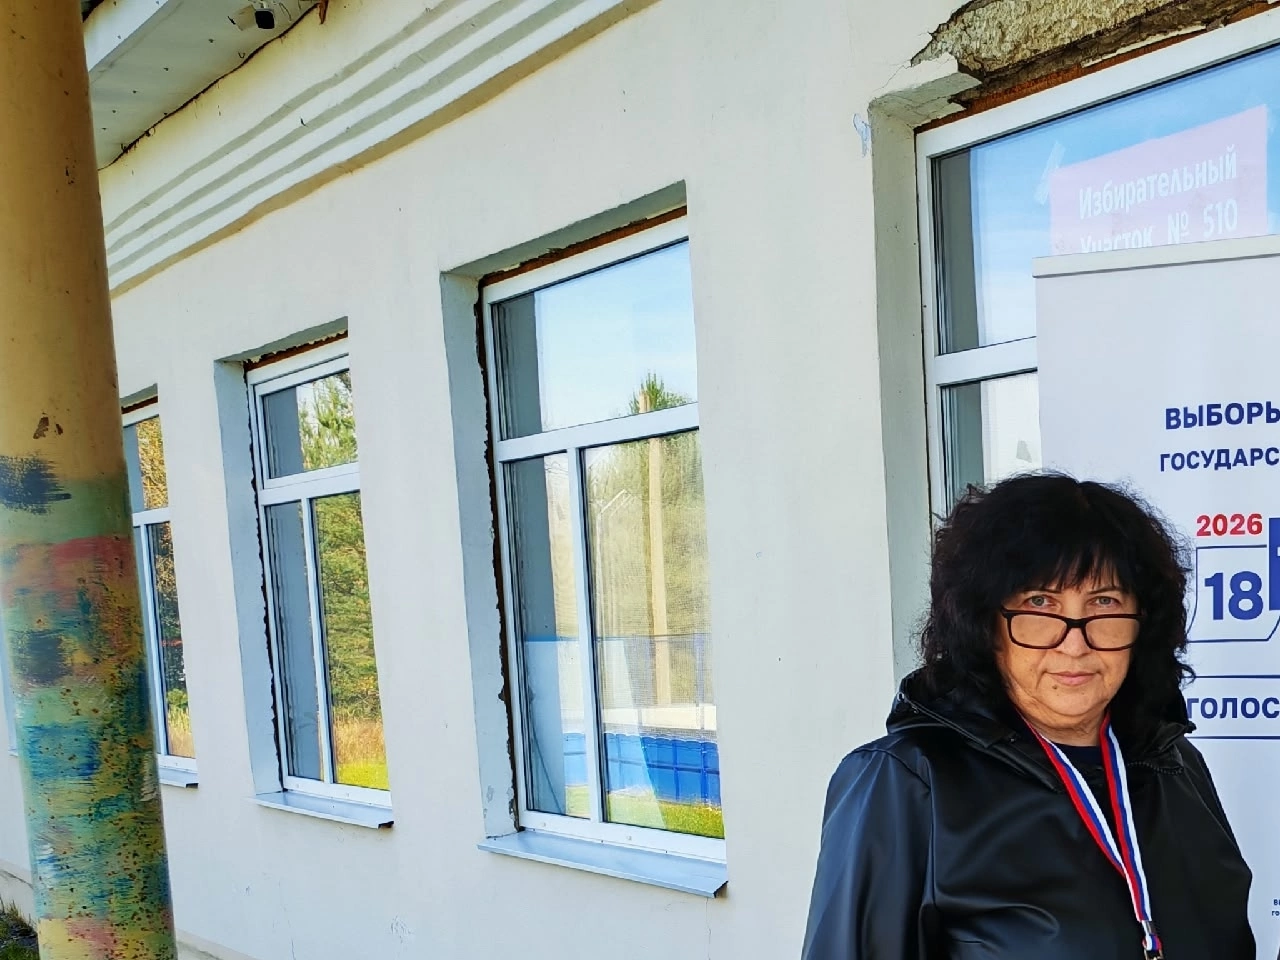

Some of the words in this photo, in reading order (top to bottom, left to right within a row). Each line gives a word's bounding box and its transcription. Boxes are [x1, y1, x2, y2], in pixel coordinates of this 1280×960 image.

[1079, 145, 1237, 220] Избирательный
[1167, 210, 1189, 245] №
[1202, 199, 1238, 238] 510
[1196, 513, 1263, 537] 2026
[1204, 571, 1263, 620] 18
[1187, 697, 1280, 719] ГОЛОС
